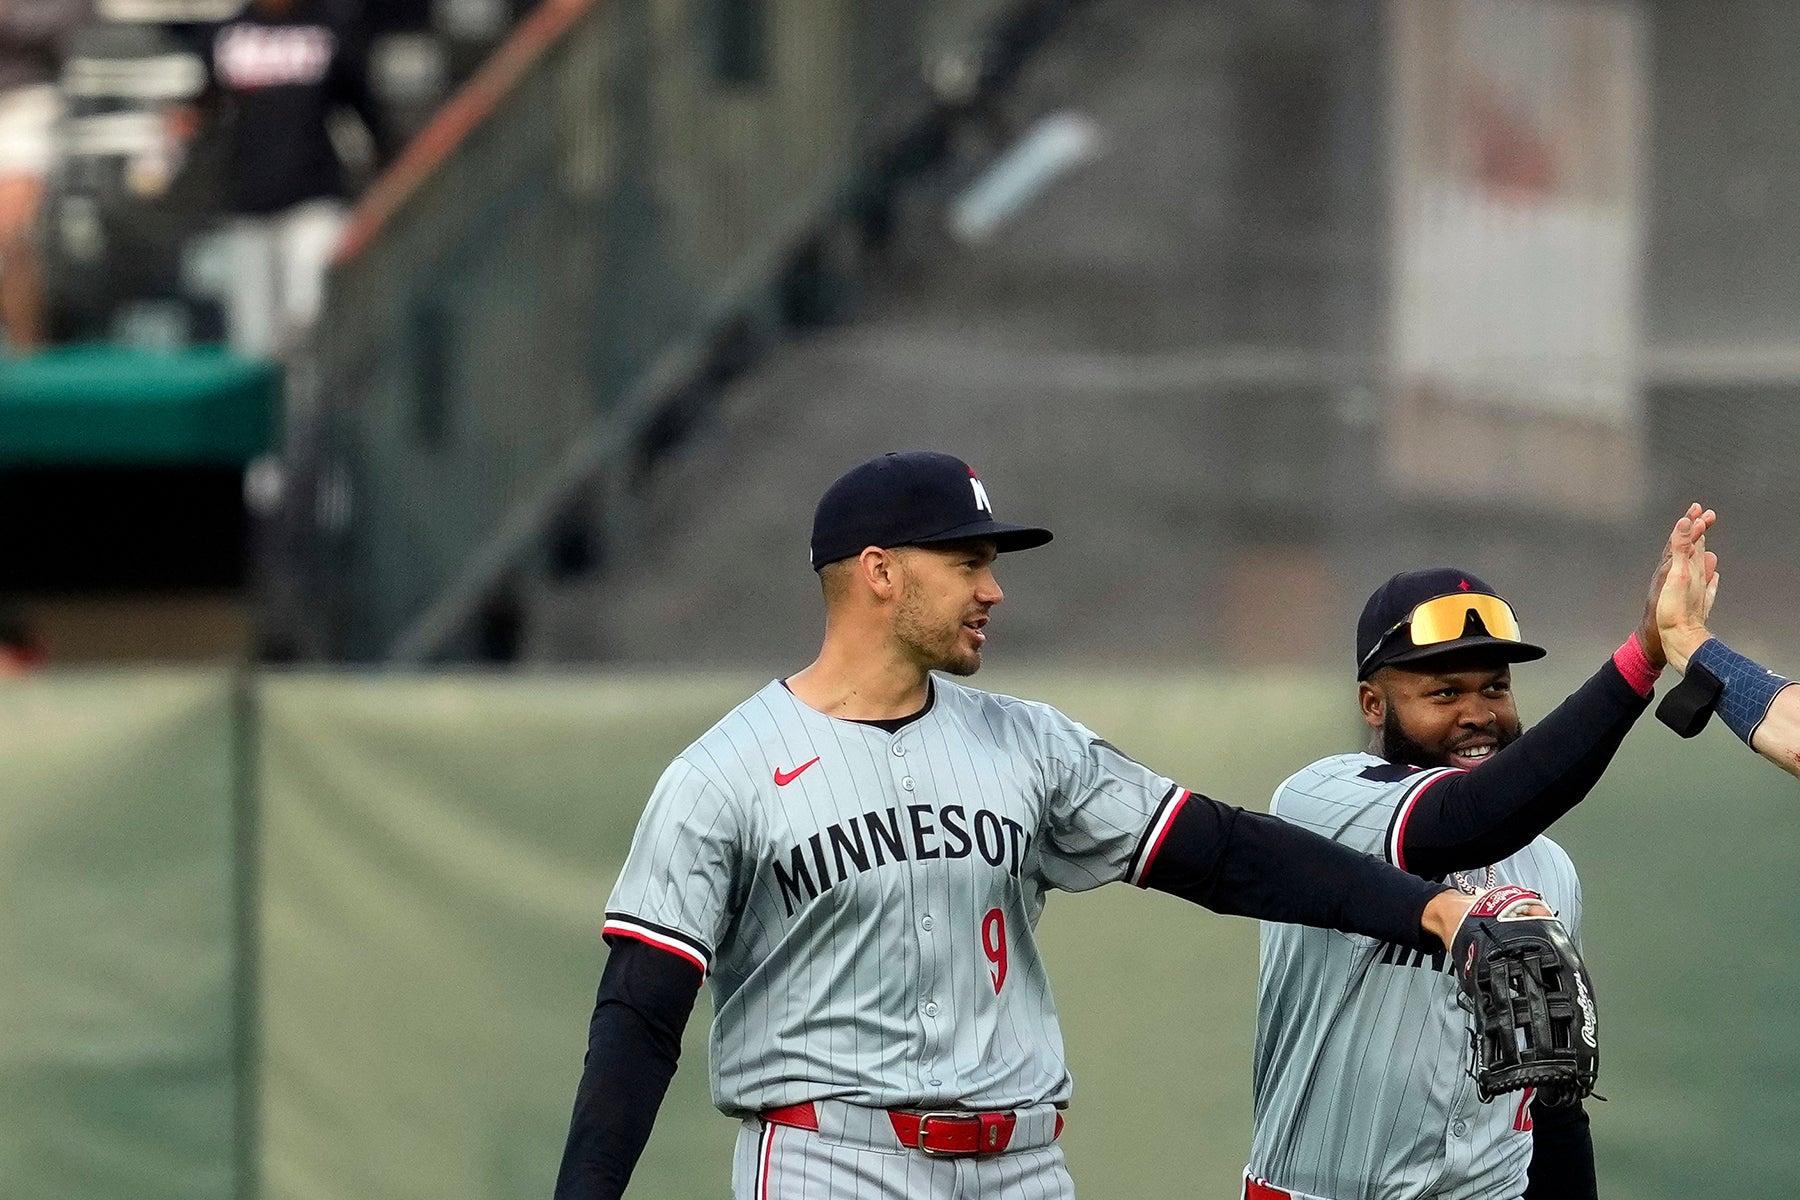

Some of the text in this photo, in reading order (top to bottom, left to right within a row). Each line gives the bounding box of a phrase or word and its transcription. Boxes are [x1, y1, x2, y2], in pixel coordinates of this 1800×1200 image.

[772, 804, 1032, 919] MINNESOT
[981, 907, 1008, 996] 9
[1573, 970, 1597, 1049] Rawlings
